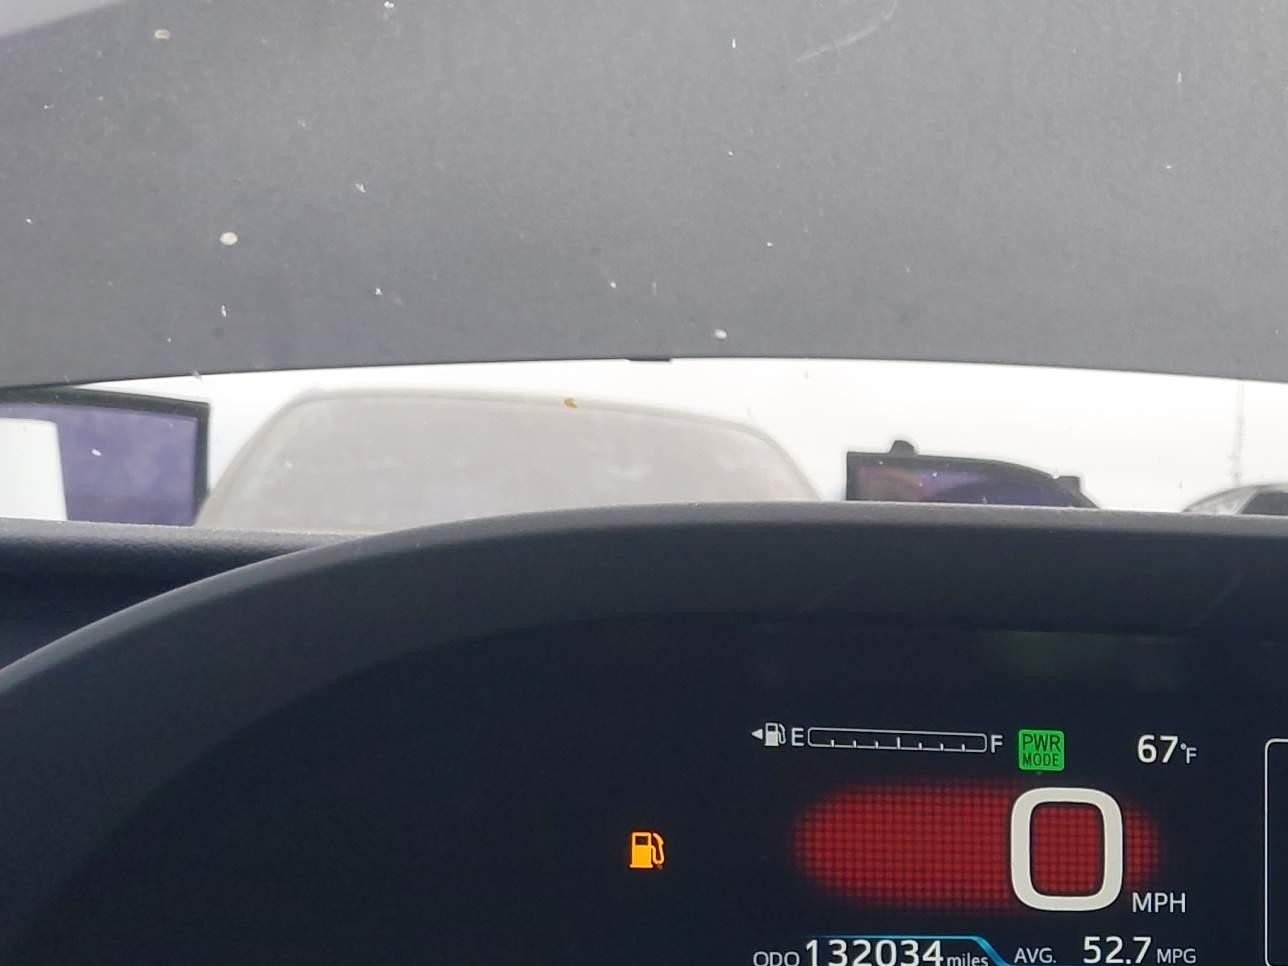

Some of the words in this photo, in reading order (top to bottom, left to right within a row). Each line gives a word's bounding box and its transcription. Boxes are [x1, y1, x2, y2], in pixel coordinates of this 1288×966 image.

[791, 727, 805, 746] E
[991, 734, 1003, 753] F
[1022, 734, 1061, 752] PWR
[1022, 753, 1060, 768] MODE
[1010, 787, 1124, 912] 0
[1131, 893, 1187, 913] MPH
[1013, 947, 1058, 965] AVG.
[1082, 936, 1153, 965] 52.7
[1156, 949, 1197, 965] MPG
